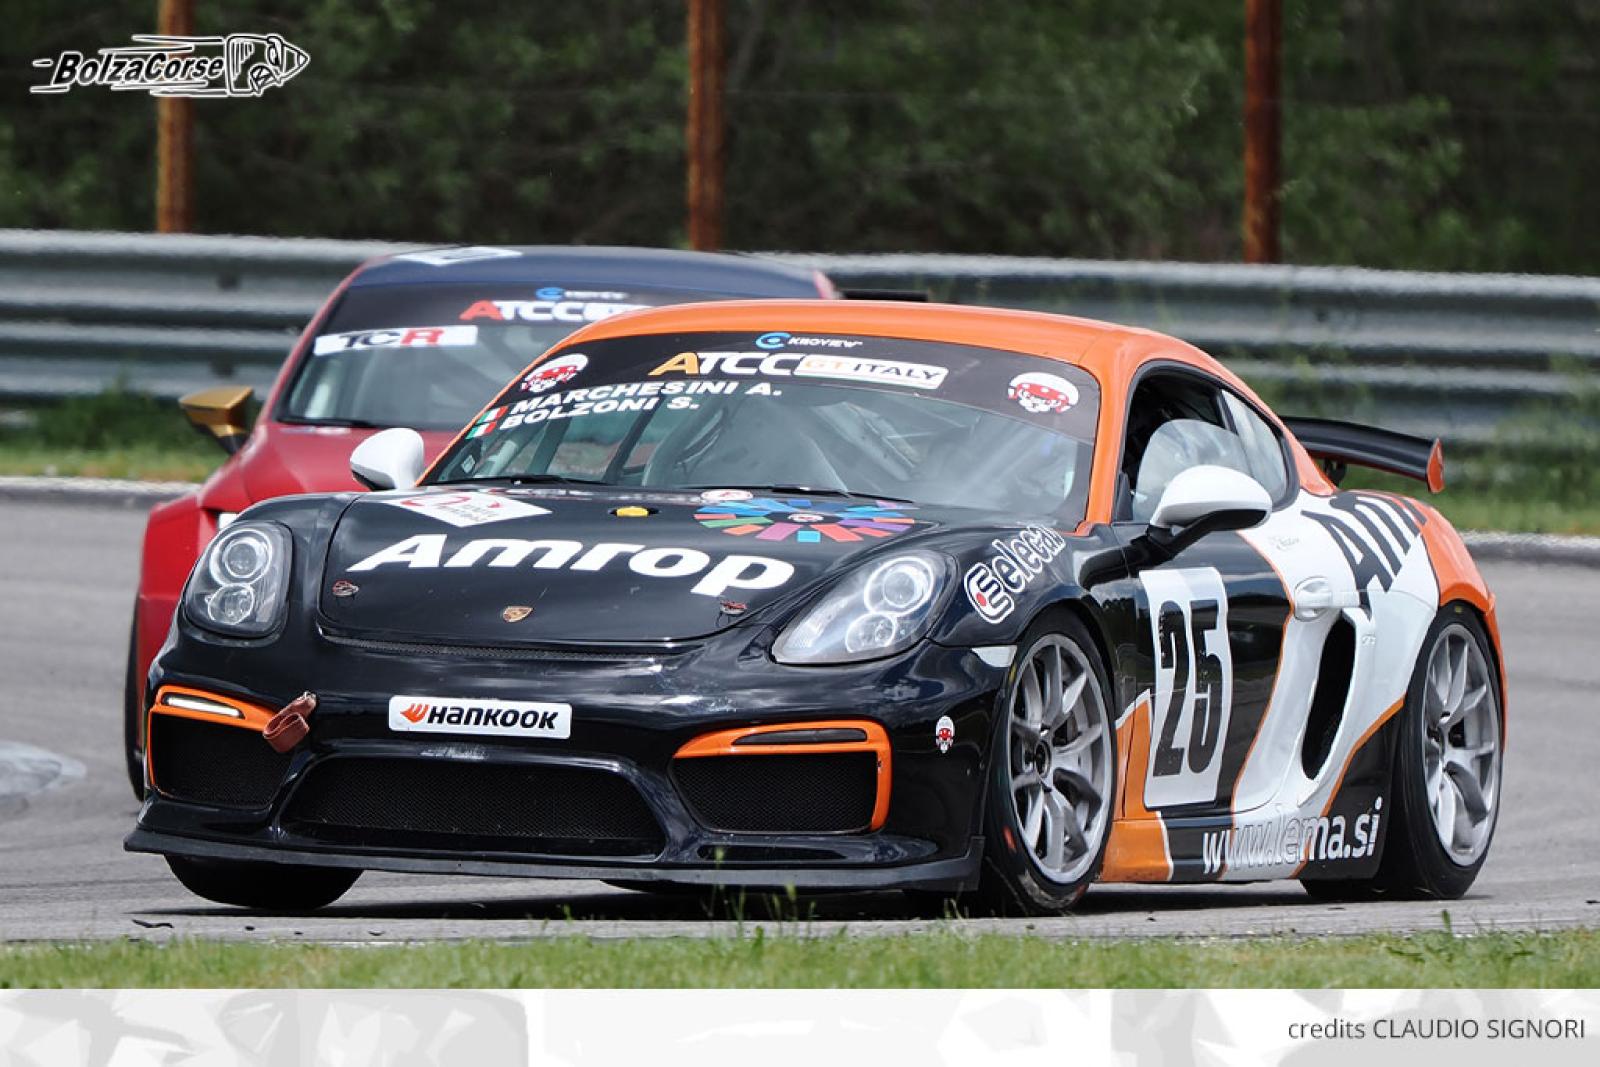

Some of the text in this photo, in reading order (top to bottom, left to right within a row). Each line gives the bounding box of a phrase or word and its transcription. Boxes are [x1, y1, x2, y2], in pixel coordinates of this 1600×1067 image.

[460, 300, 585, 321] ATCC
[339, 328, 445, 348] TCR
[648, 351, 941, 380] ATCC GT ITALY
[499, 396, 700, 431] BOLZONI S.
[511, 380, 783, 415] MARCHESINI A.
[346, 533, 796, 597] Amrop
[1152, 599, 1223, 777] 25
[1202, 796, 1383, 875] www.lema.si
